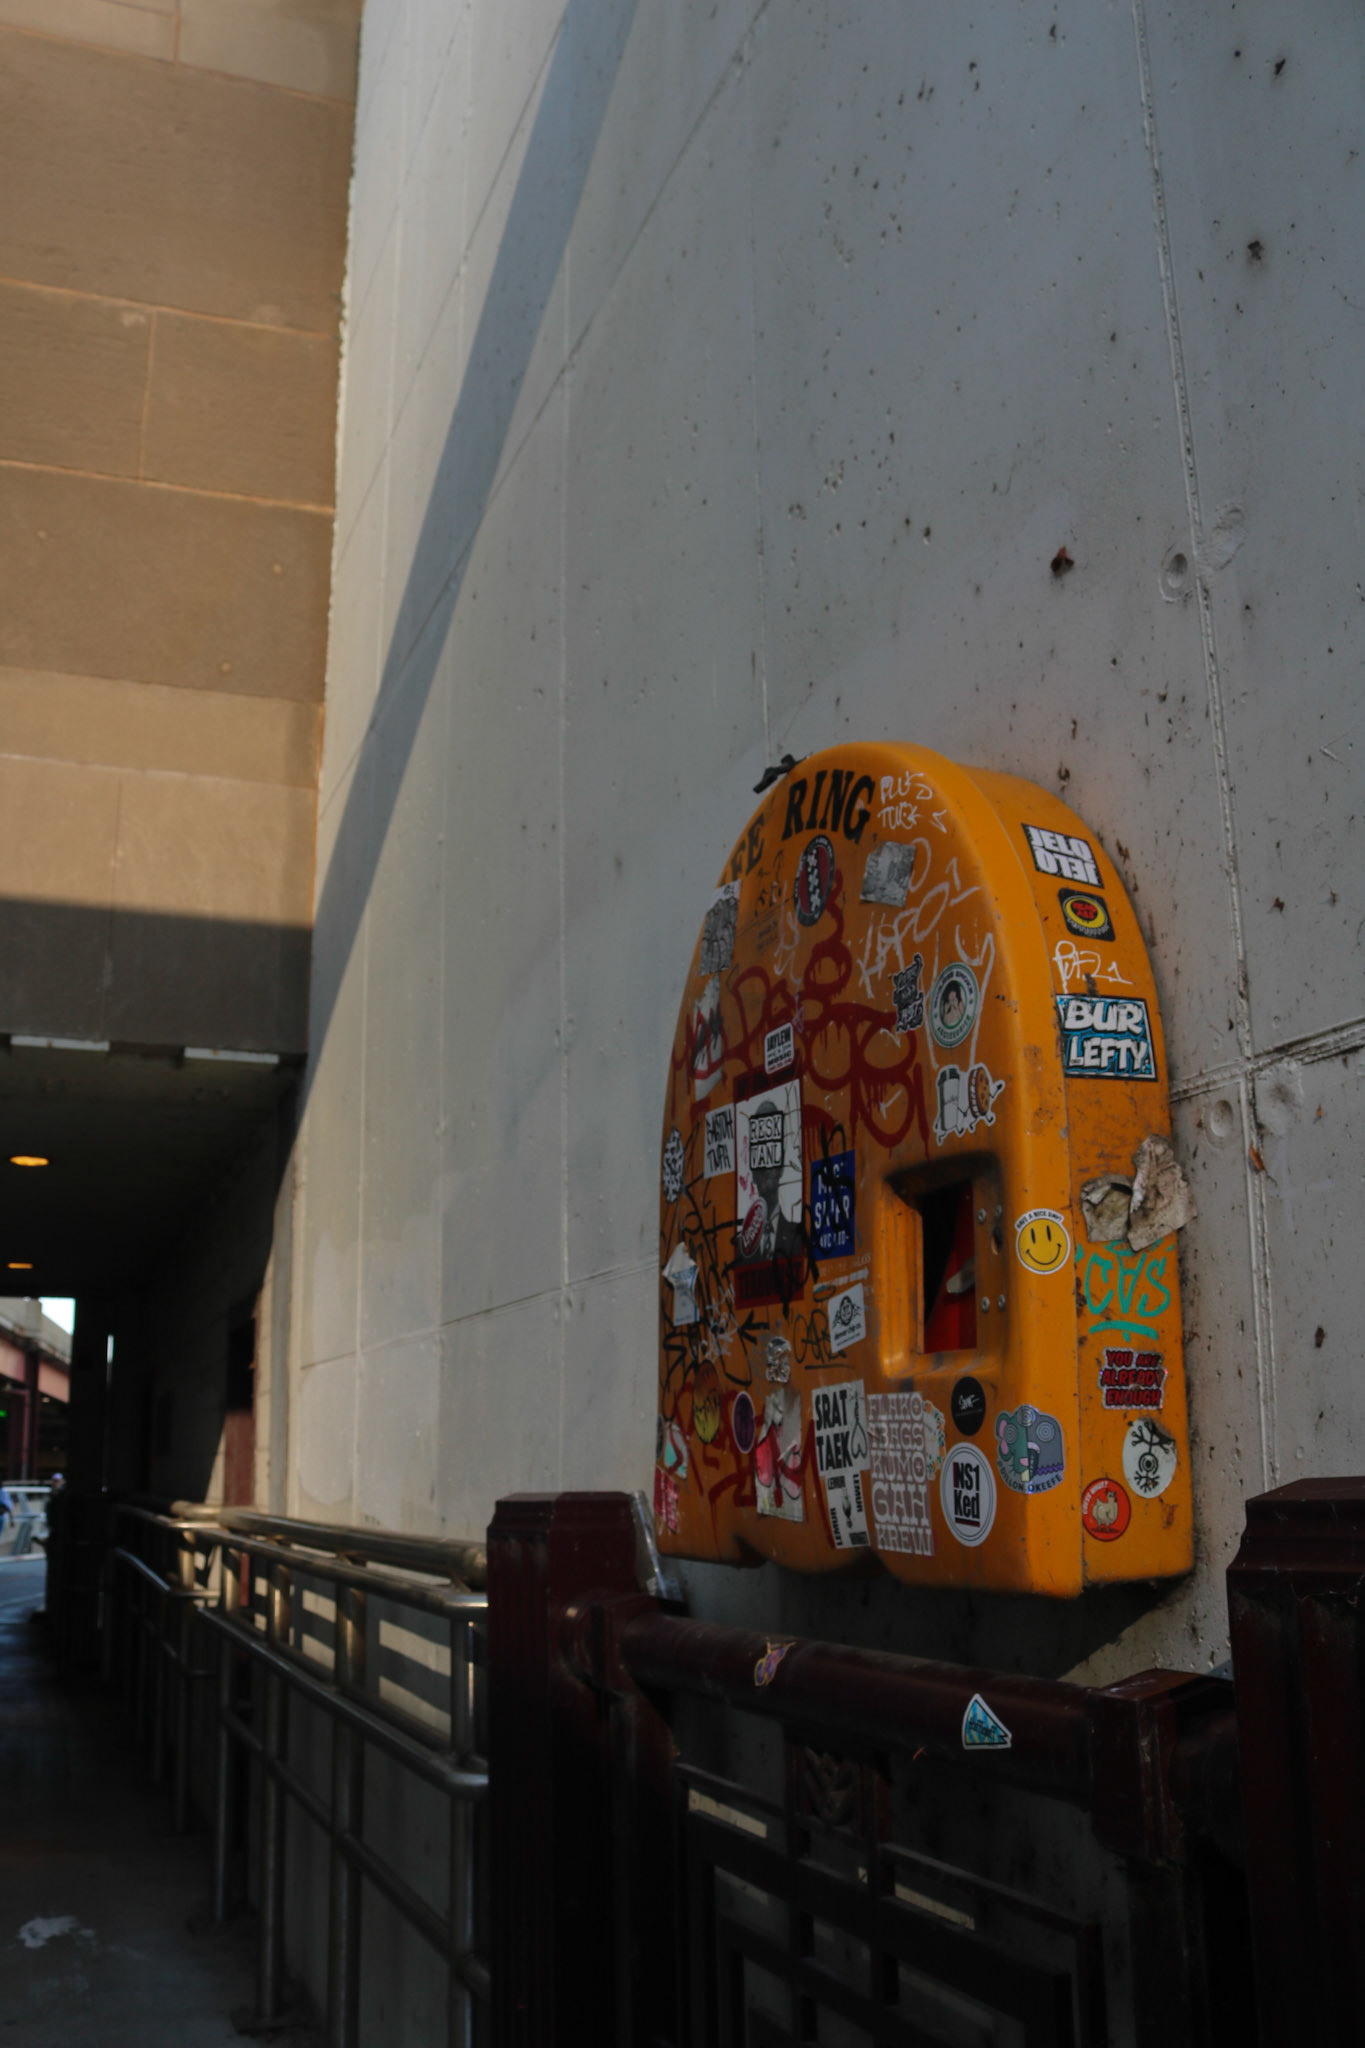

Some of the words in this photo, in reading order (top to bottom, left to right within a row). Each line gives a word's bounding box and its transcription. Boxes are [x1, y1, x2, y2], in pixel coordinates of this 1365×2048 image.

[782, 769, 875, 844] RING
[1065, 998, 1144, 1035] BUR
[1068, 1036, 1148, 1070] LEFTY
[1106, 1350, 1133, 1367] YOU
[1136, 1354, 1160, 1367] ARE
[1101, 1369, 1163, 1387] ALREADY
[815, 1389, 847, 1431] SRAT
[1106, 1389, 1161, 1406] ENOUGH
[817, 1430, 853, 1471] TAEK
